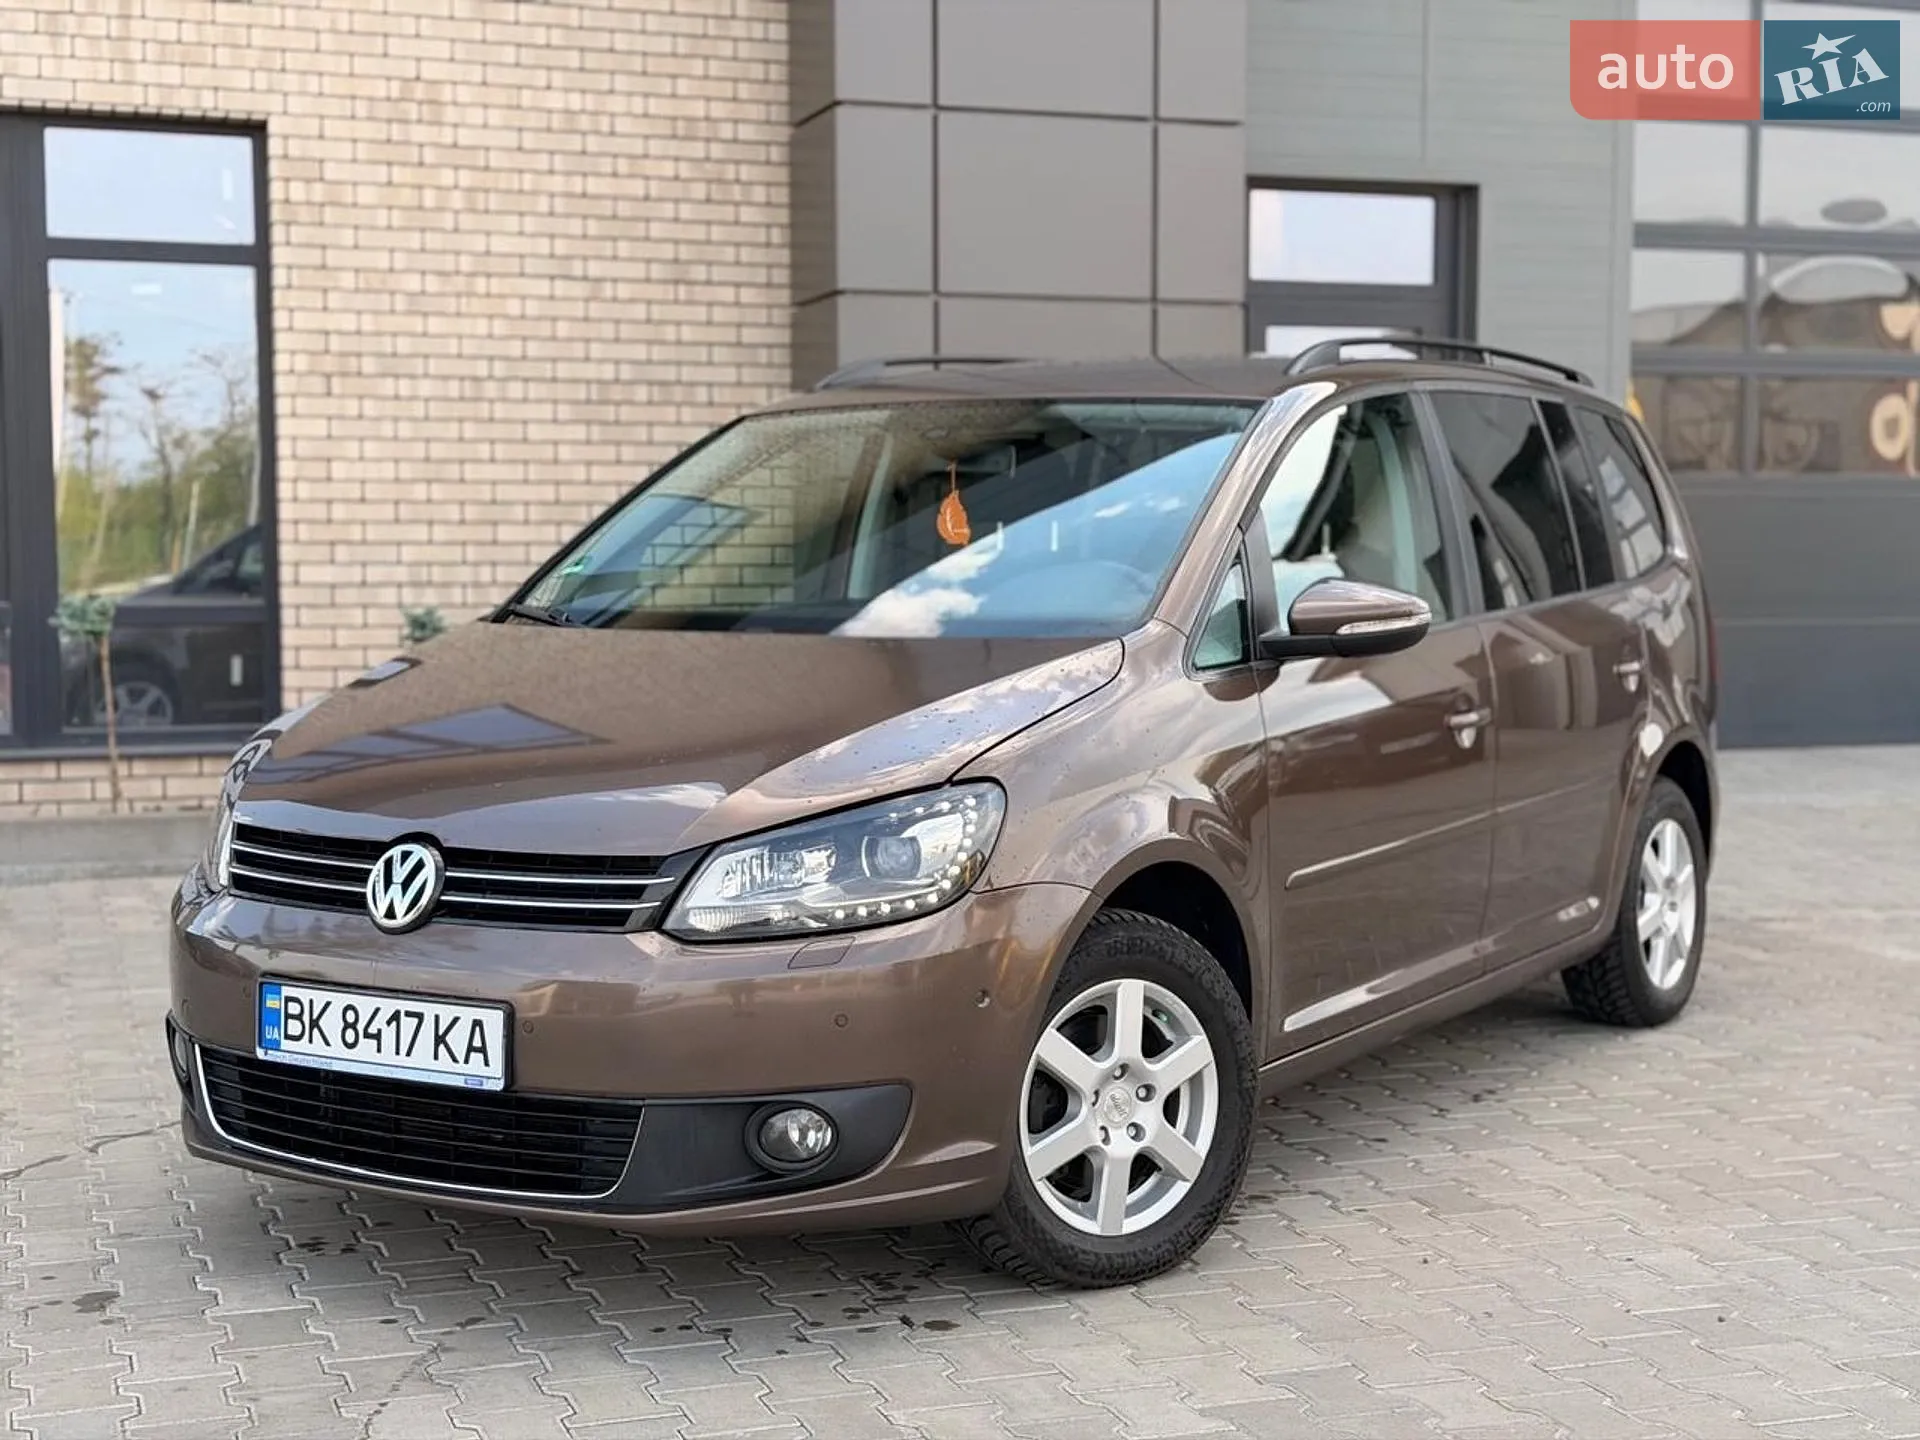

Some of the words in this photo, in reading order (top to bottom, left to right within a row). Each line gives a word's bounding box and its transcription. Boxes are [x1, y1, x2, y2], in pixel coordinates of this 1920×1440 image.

[265, 1024, 279, 1040] UA
[283, 996, 332, 1047] BK
[341, 1003, 425, 1057] 8417
[433, 1013, 490, 1067] KA
